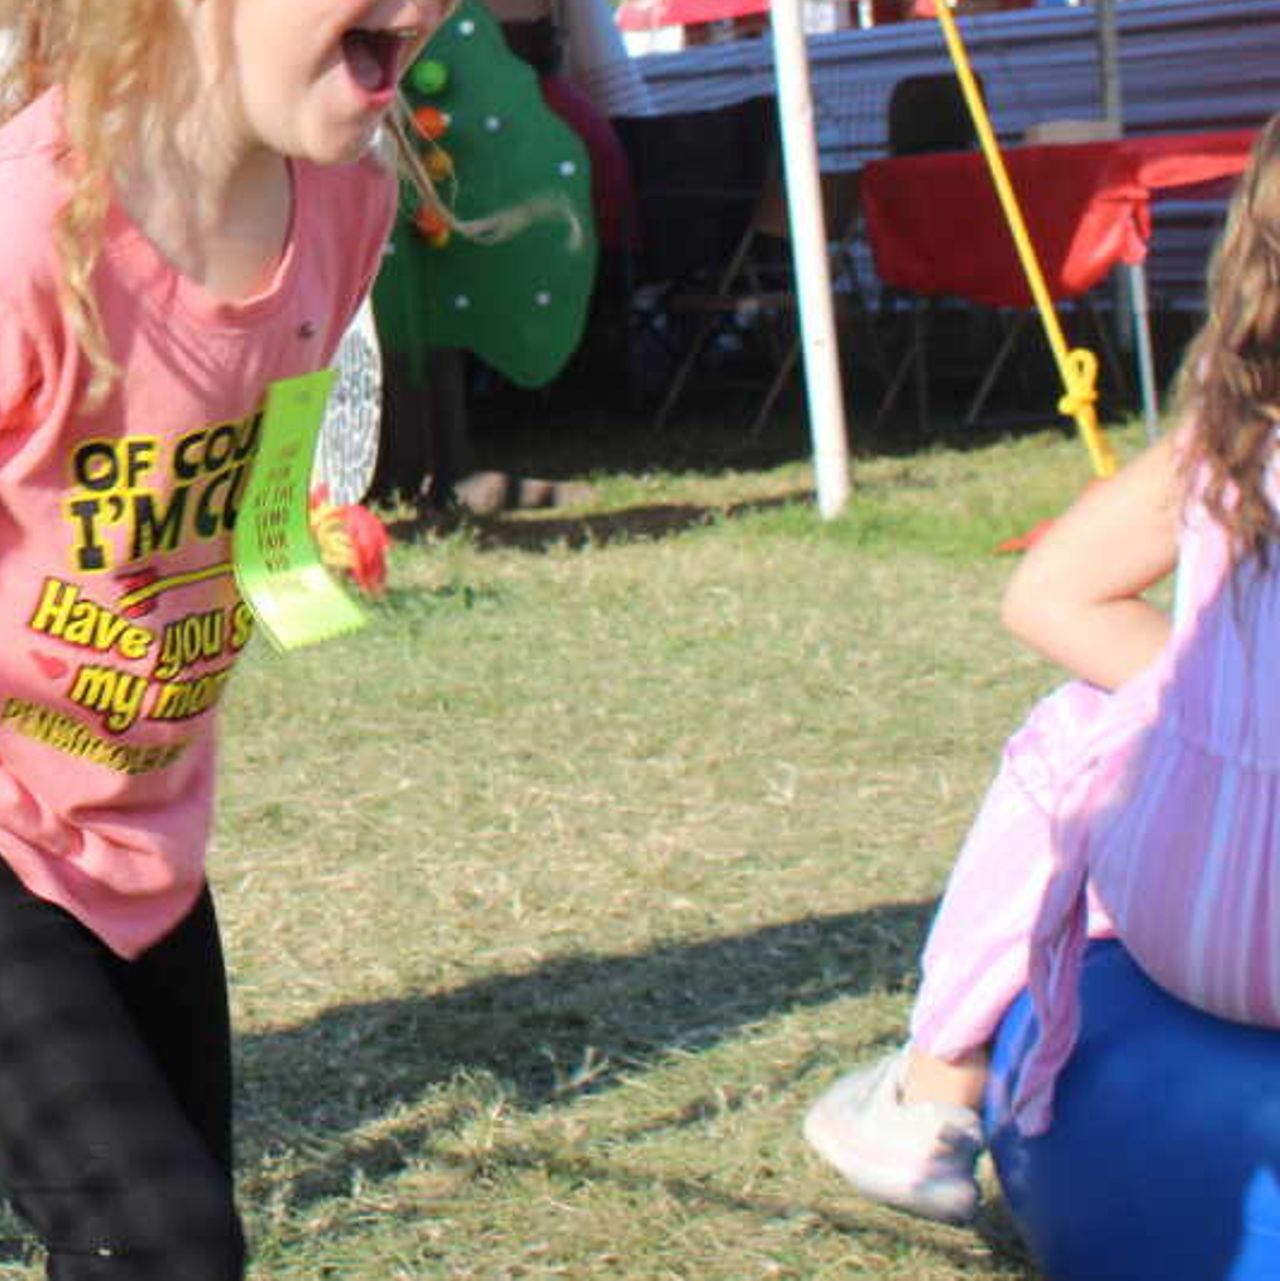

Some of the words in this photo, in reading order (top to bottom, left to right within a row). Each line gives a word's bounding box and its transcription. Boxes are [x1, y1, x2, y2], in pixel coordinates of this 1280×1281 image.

[73, 439, 156, 493] OF
[173, 410, 264, 479] COU
[70, 483, 189, 570] I'M
[30, 577, 154, 660] Have
[151, 608, 226, 681] you
[69, 663, 149, 735] my
